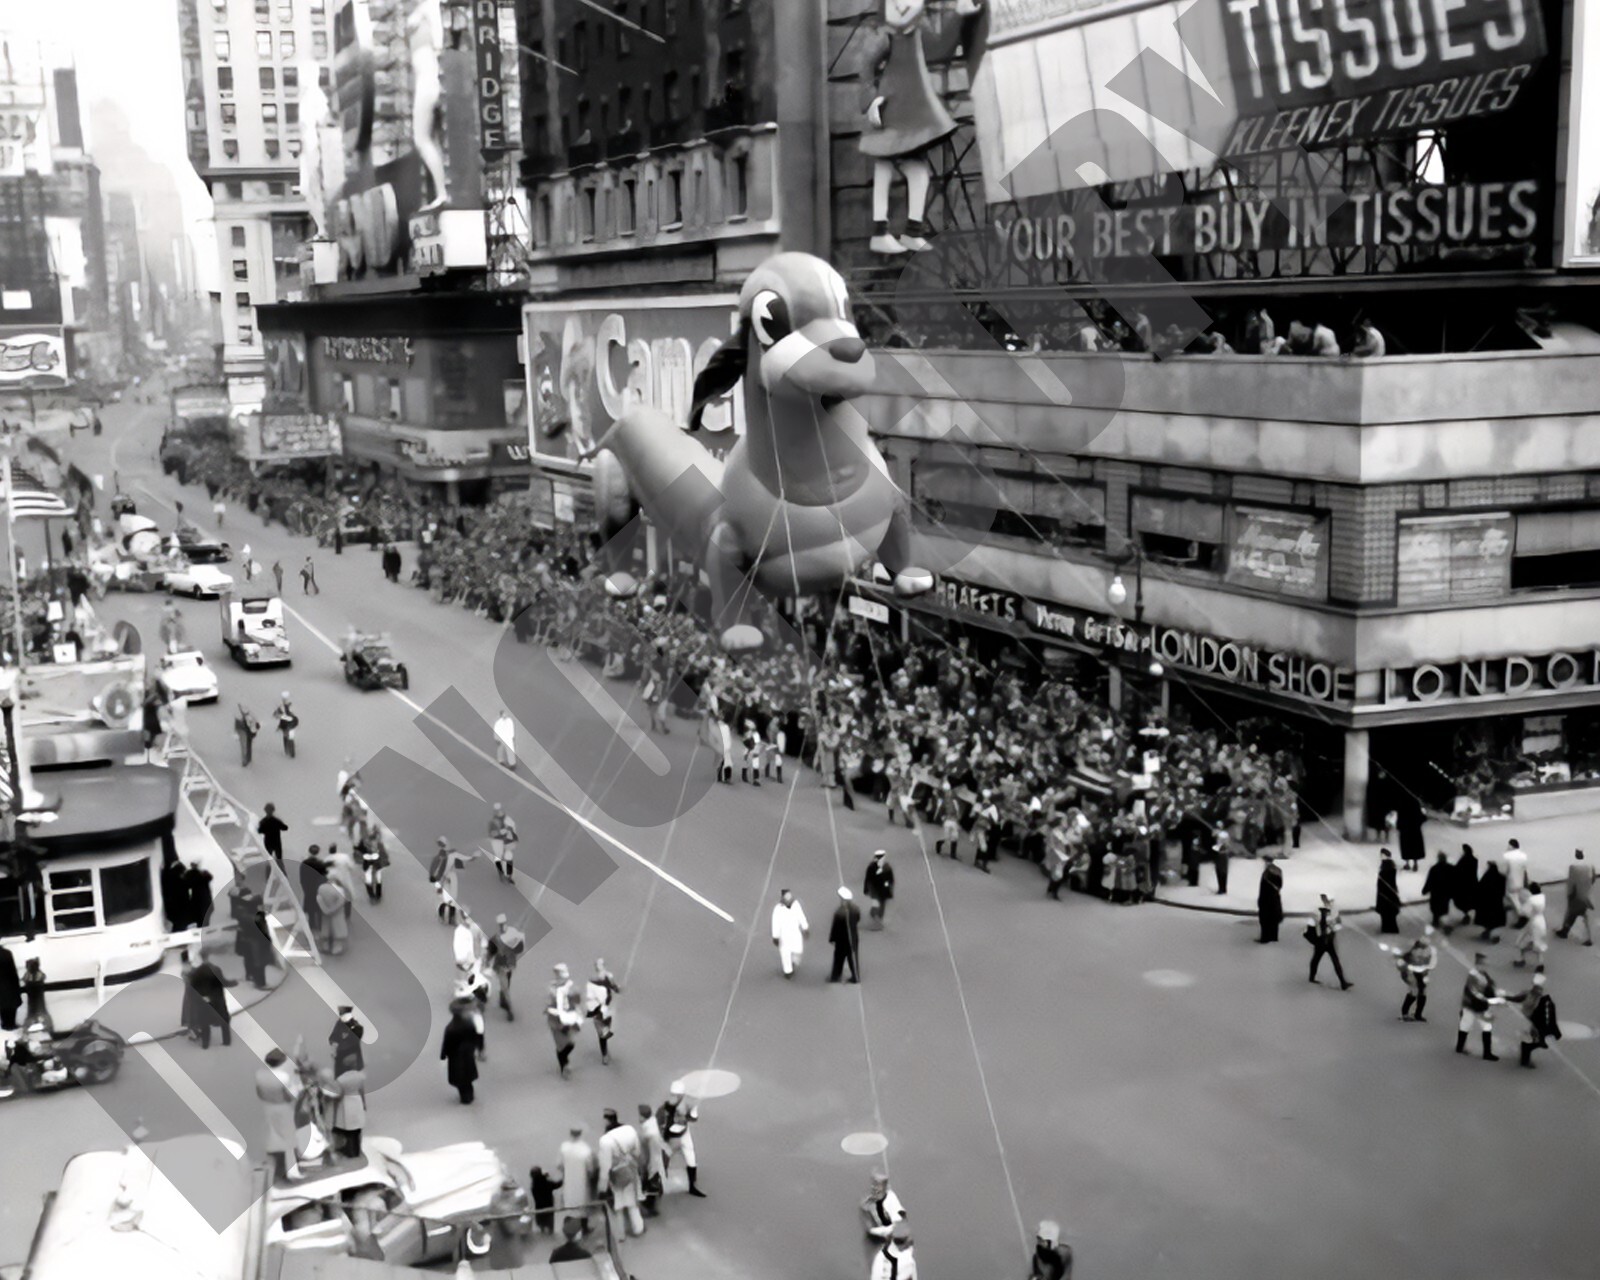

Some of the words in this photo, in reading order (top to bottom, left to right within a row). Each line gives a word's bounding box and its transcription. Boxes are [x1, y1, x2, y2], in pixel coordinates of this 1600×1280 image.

[1225, 96, 1372, 157] KLEENEX
[1373, 64, 1531, 132] TISSUES
[994, 215, 1077, 262] YOUR
[1092, 206, 1176, 258] BEST
[1194, 199, 1270, 253] BUY
[1287, 196, 1328, 248] IN
[1350, 180, 1539, 244] TISSUES
[1151, 625, 1259, 683] LONDON
[1268, 651, 1354, 705] SHOE
